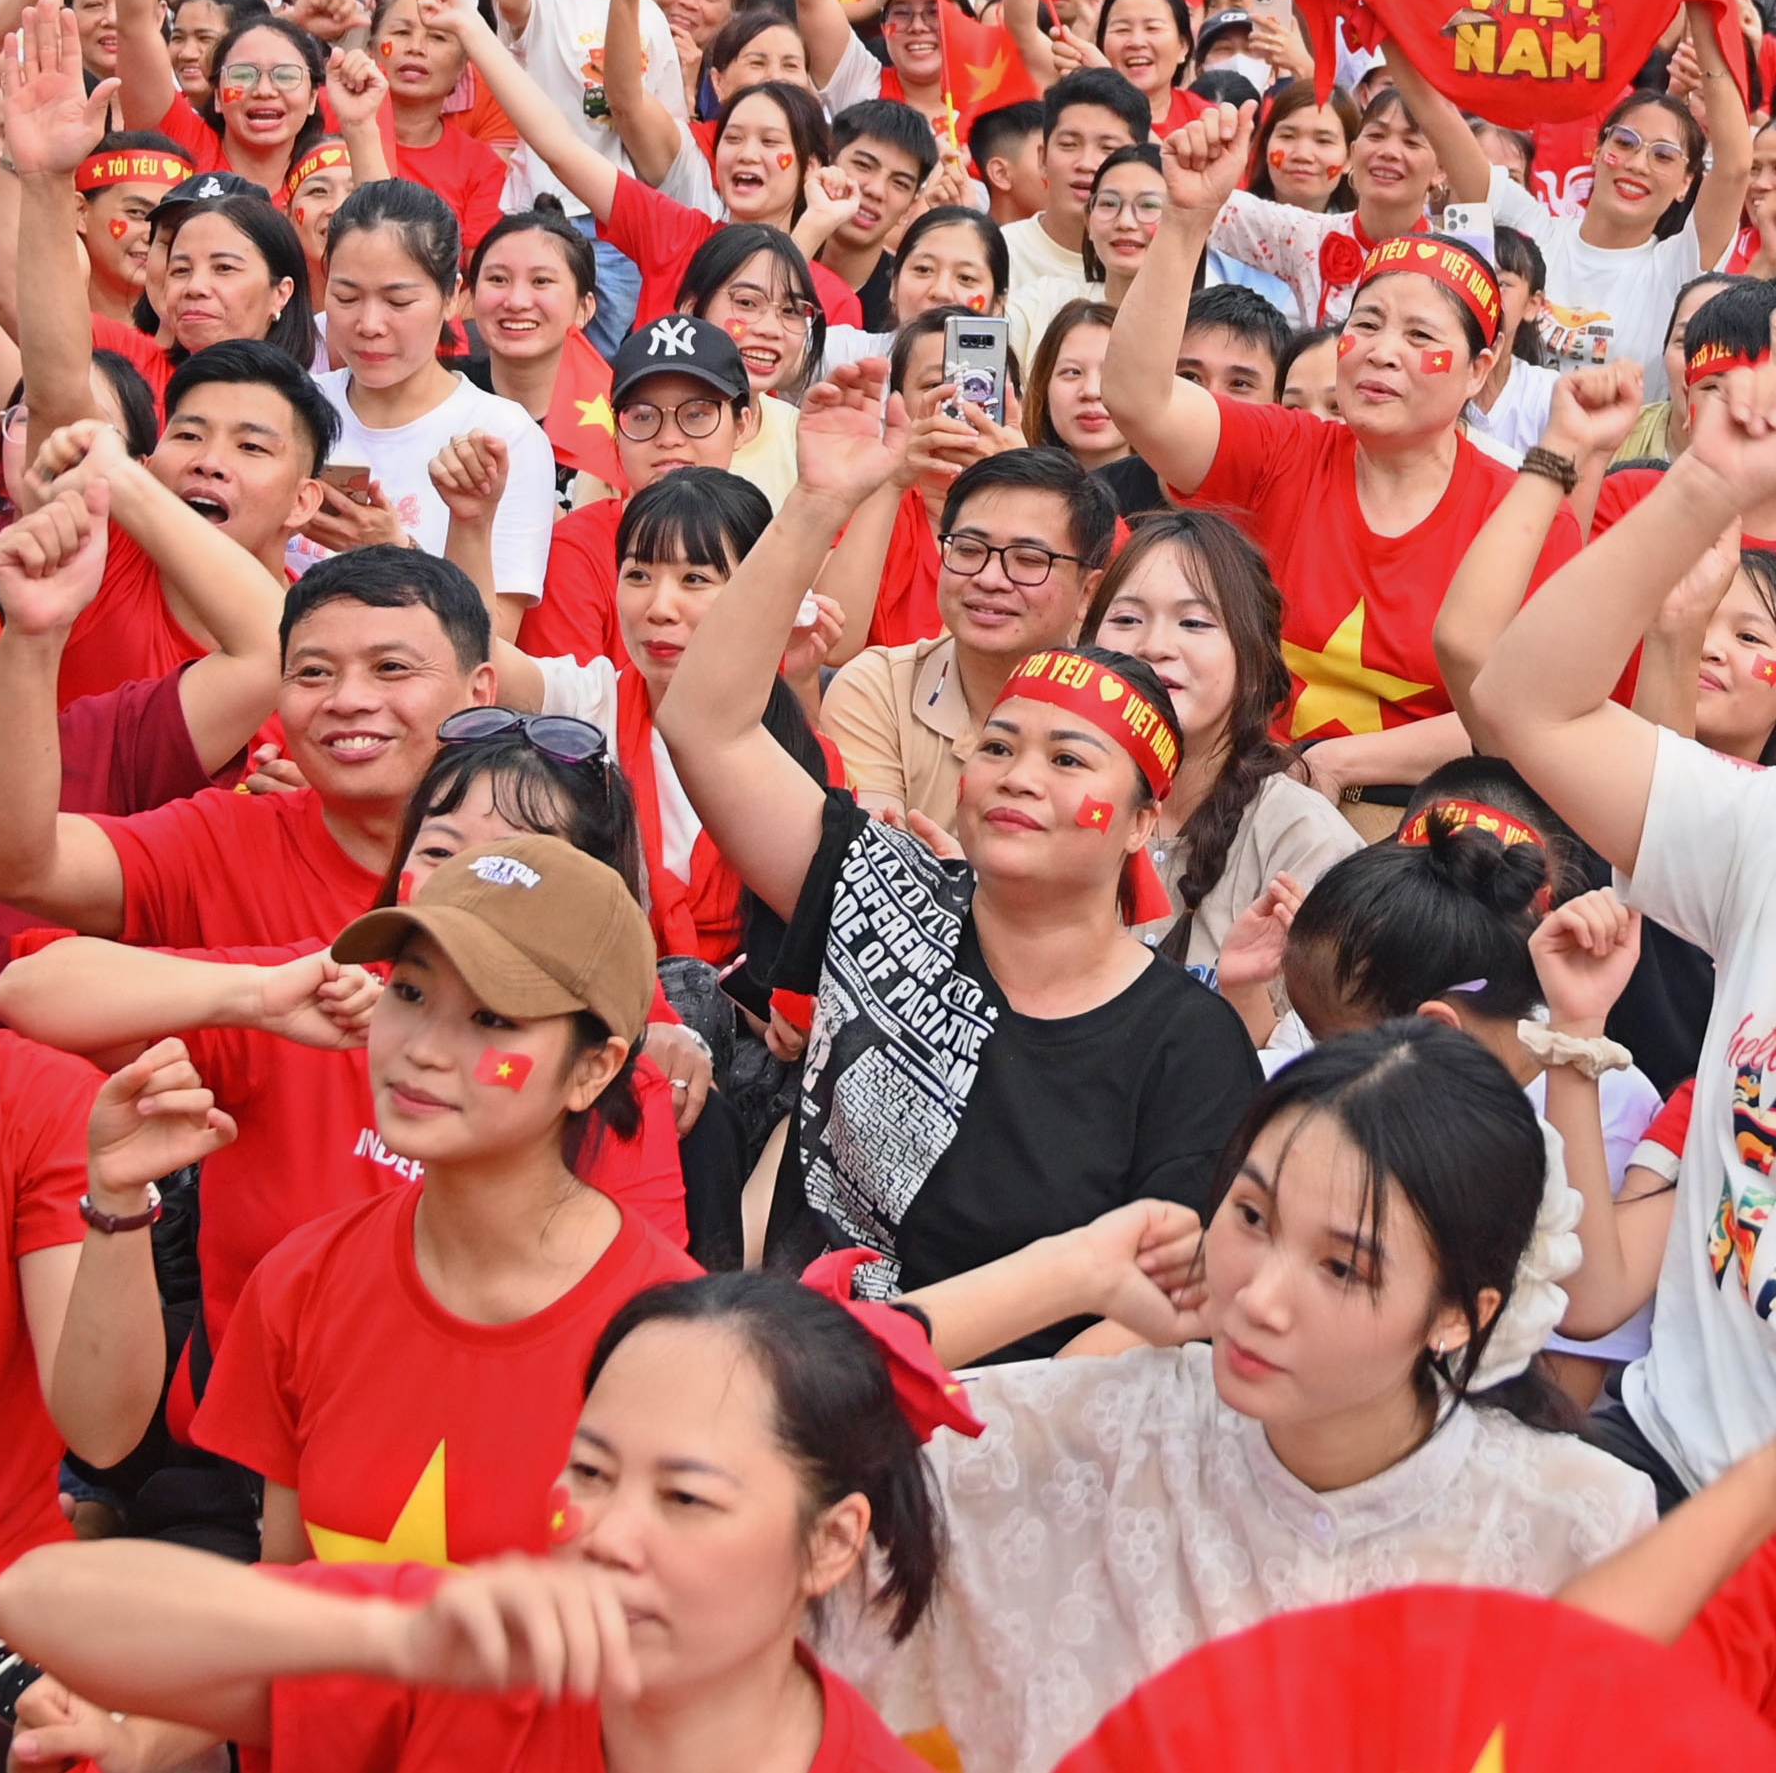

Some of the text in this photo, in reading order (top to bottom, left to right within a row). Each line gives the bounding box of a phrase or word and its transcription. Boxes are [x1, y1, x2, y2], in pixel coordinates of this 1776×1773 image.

[1453, 25, 1602, 80] NAM
[108, 153, 157, 176] TÔI YÊU
[299, 153, 317, 176] YÊU
[1380, 239, 1411, 260] YÊU
[1439, 245, 1471, 282] VIỆT
[1467, 269, 1493, 306] NAM
[647, 318, 697, 357] NY
[1021, 650, 1175, 773] TÔI YÊU VIỆT NAM
[857, 941, 899, 982] OF
